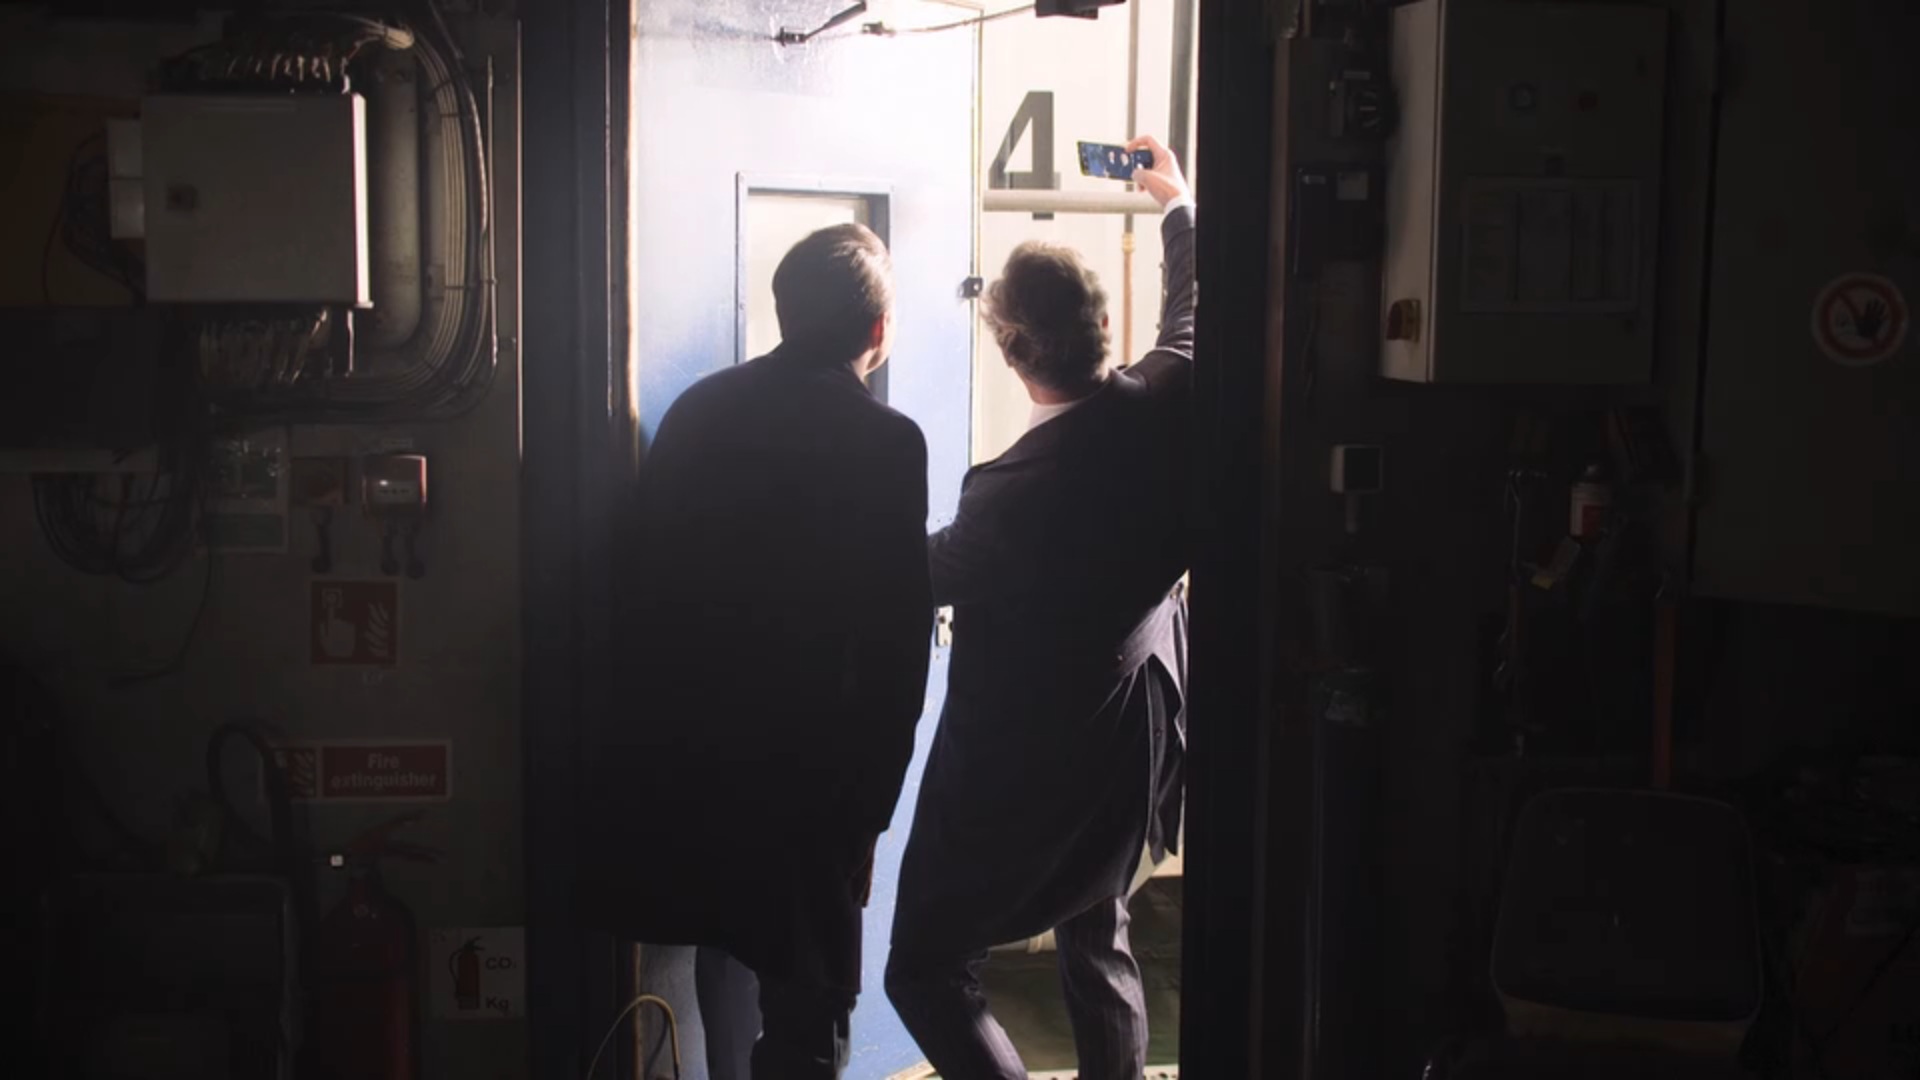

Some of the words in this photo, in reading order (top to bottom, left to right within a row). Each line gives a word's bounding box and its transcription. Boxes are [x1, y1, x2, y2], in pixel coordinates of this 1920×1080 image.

[989, 91, 1061, 220] 4
[367, 752, 400, 769] Fire
[330, 770, 437, 791] extinguisher
[485, 996, 509, 1014] Kg
